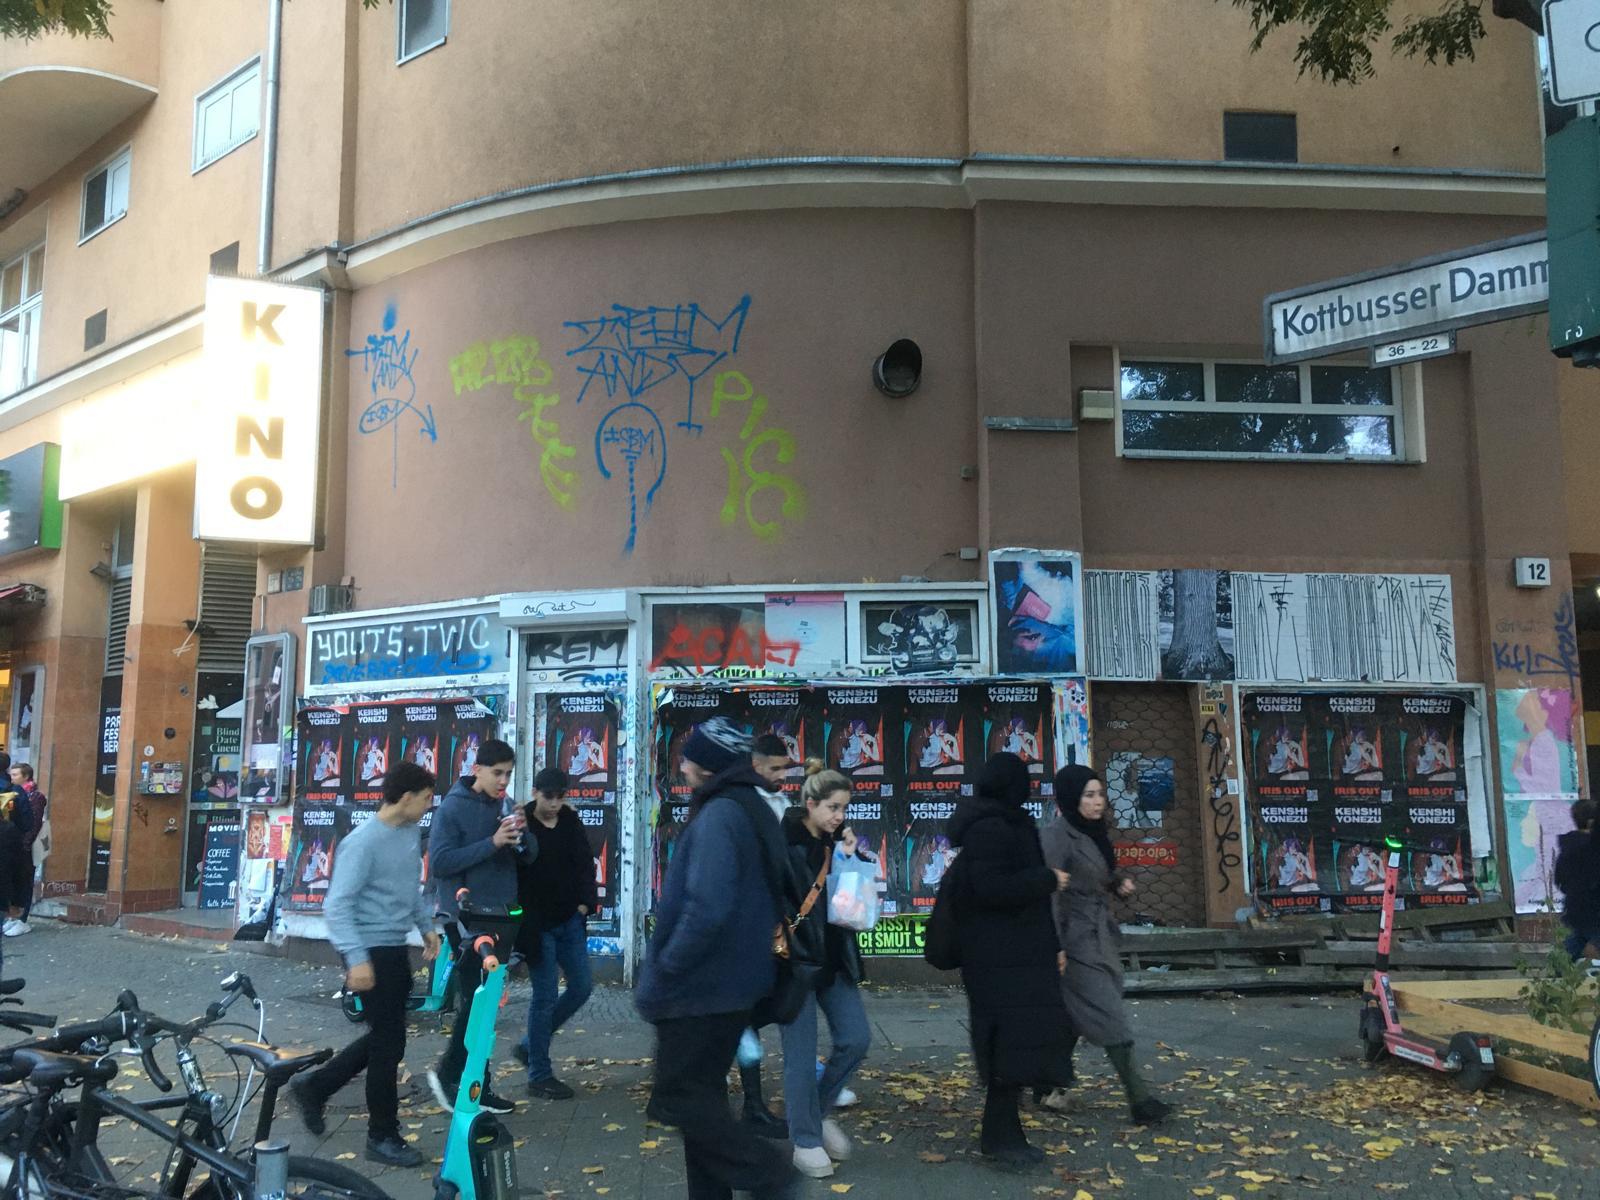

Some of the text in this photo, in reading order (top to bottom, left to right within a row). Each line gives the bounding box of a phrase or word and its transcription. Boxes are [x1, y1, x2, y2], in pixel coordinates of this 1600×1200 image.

[1282, 260, 1549, 339] Kottbusser Damm
[1388, 344, 1405, 357] 36
[1421, 338, 1439, 351] 22
[230, 301, 287, 520] KINO
[1528, 563, 1546, 580] 12
[908, 688, 958, 696] KENSHI
[561, 697, 604, 705] KENSHI
[357, 708, 388, 716] KENSHI
[405, 706, 437, 714] KENSHI
[454, 704, 475, 712] KENS
[562, 705, 604, 713] YONEZU
[406, 713, 437, 721] YONEZU
[456, 711, 485, 719] YONEZU
[309, 718, 340, 726] YONEZU
[217, 728, 240, 736] Blind
[209, 744, 240, 752] Cinem
[856, 782, 881, 790] OUT
[936, 782, 961, 790] OUT
[582, 789, 604, 797] OUT
[910, 803, 957, 811] KENSH
[1261, 807, 1307, 815] KENSHI
[304, 811, 335, 819] KENSHI
[1409, 808, 1455, 816] KENSHI
[304, 818, 334, 826] YONEZU
[1336, 816, 1381, 824] YONEZU
[207, 848, 231, 857] COFFEE
[1297, 896, 1320, 905] OUT
[1445, 895, 1468, 903] OUT
[875, 918, 910, 932] SISSY
[875, 932, 911, 947] SMUT
